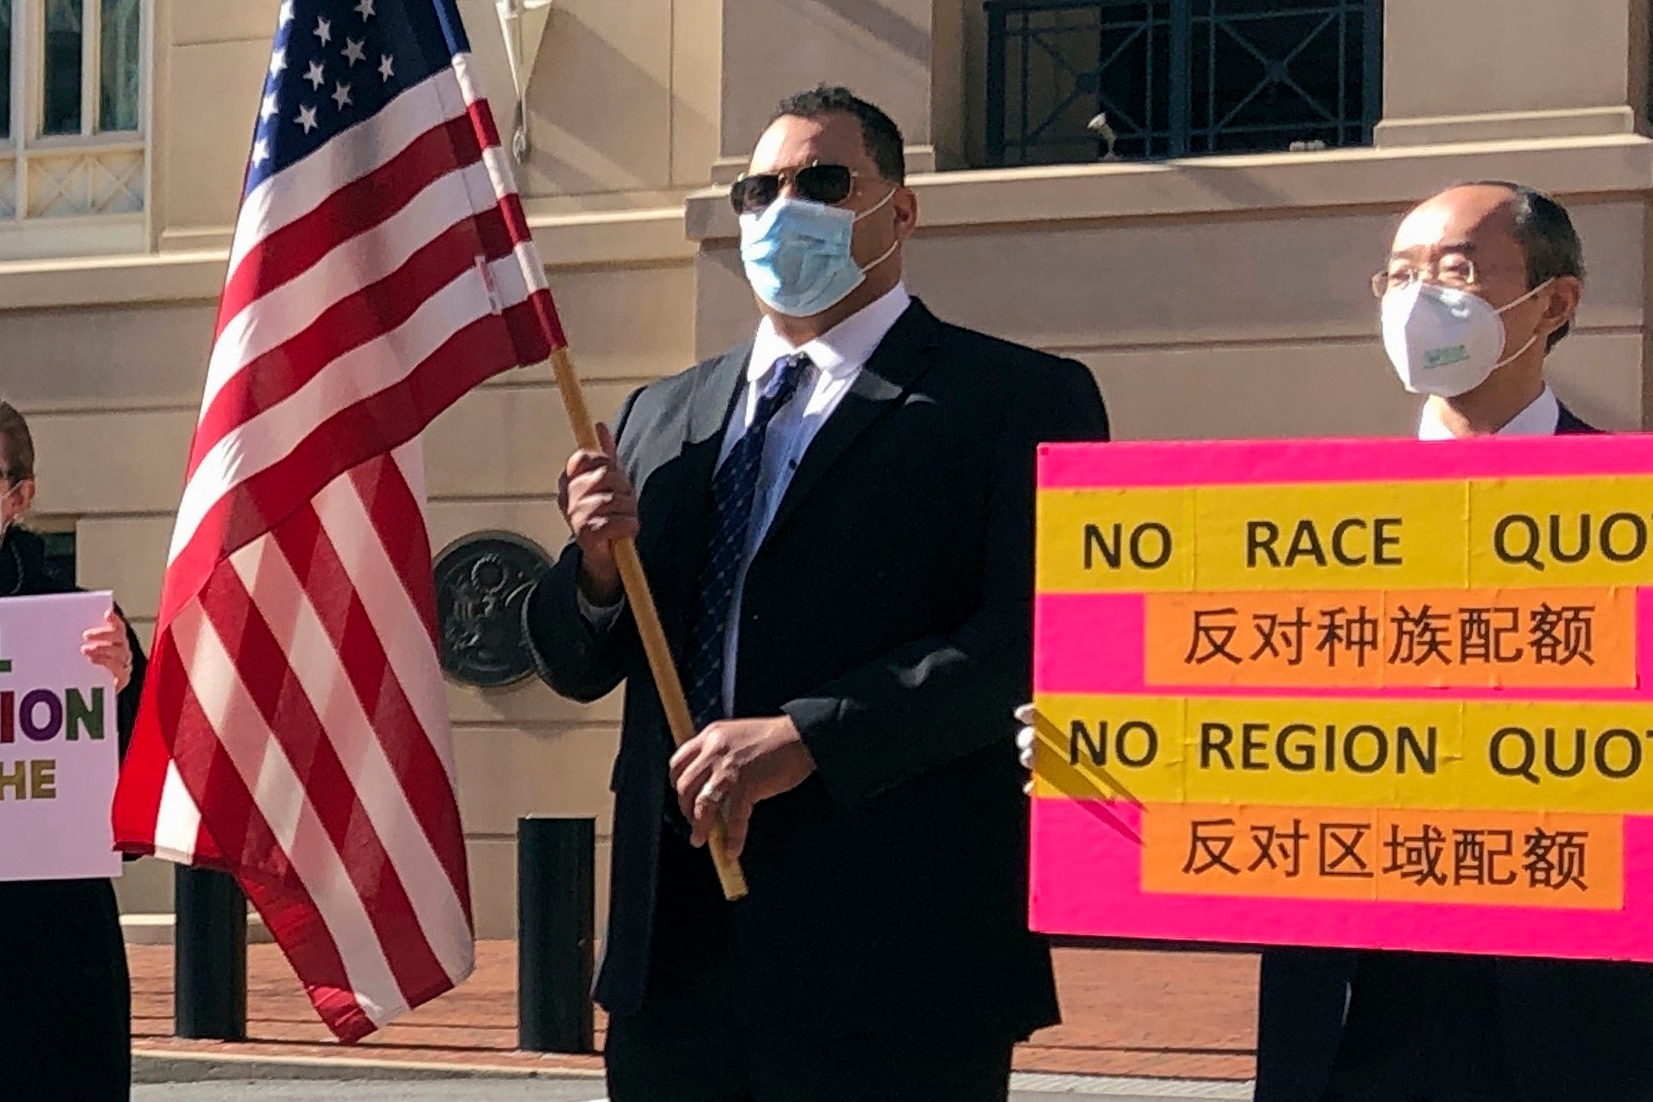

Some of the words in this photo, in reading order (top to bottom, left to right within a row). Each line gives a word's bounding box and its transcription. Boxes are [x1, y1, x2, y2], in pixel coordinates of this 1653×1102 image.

[1083, 521, 1173, 571] NO
[1246, 517, 1404, 569] RACE
[1493, 511, 1653, 572] QUO
[1183, 601, 1596, 668] 反对种族配额
[1068, 719, 1159, 768] NO
[1200, 721, 1438, 775] REGION
[1488, 727, 1653, 786] QUO
[1181, 817, 1589, 893] 反对区域配额
